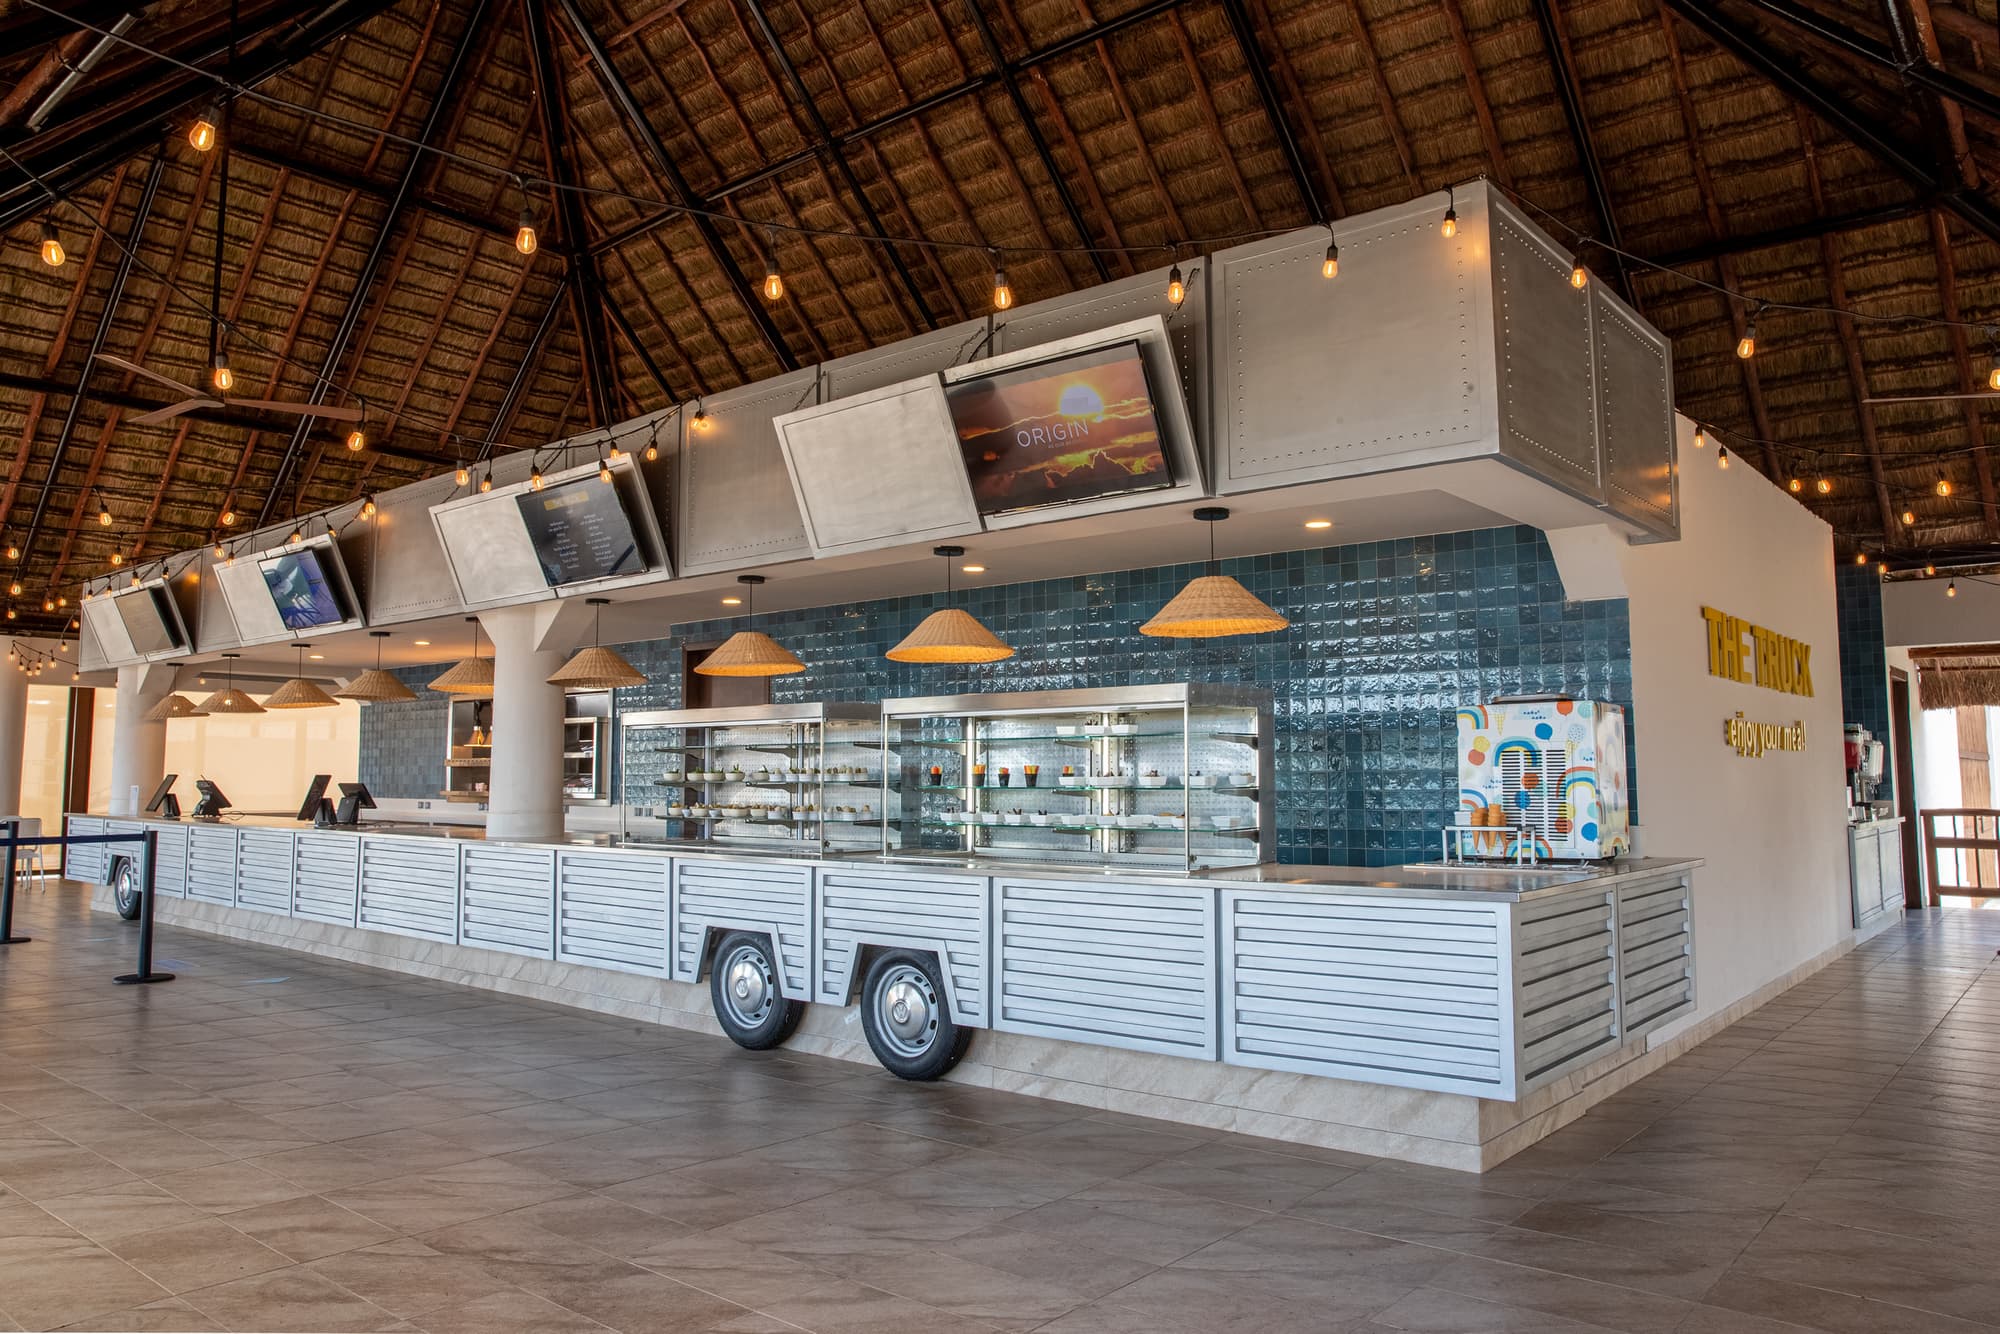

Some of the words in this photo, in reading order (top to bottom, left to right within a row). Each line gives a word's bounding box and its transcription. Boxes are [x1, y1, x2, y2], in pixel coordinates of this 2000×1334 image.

[1017, 420, 1089, 447] ORIGIN
[1702, 606, 1752, 684] THE
[1752, 625, 1814, 697] TRUCK
[1729, 711, 1758, 757] enjoy
[1759, 723, 1781, 758] your
